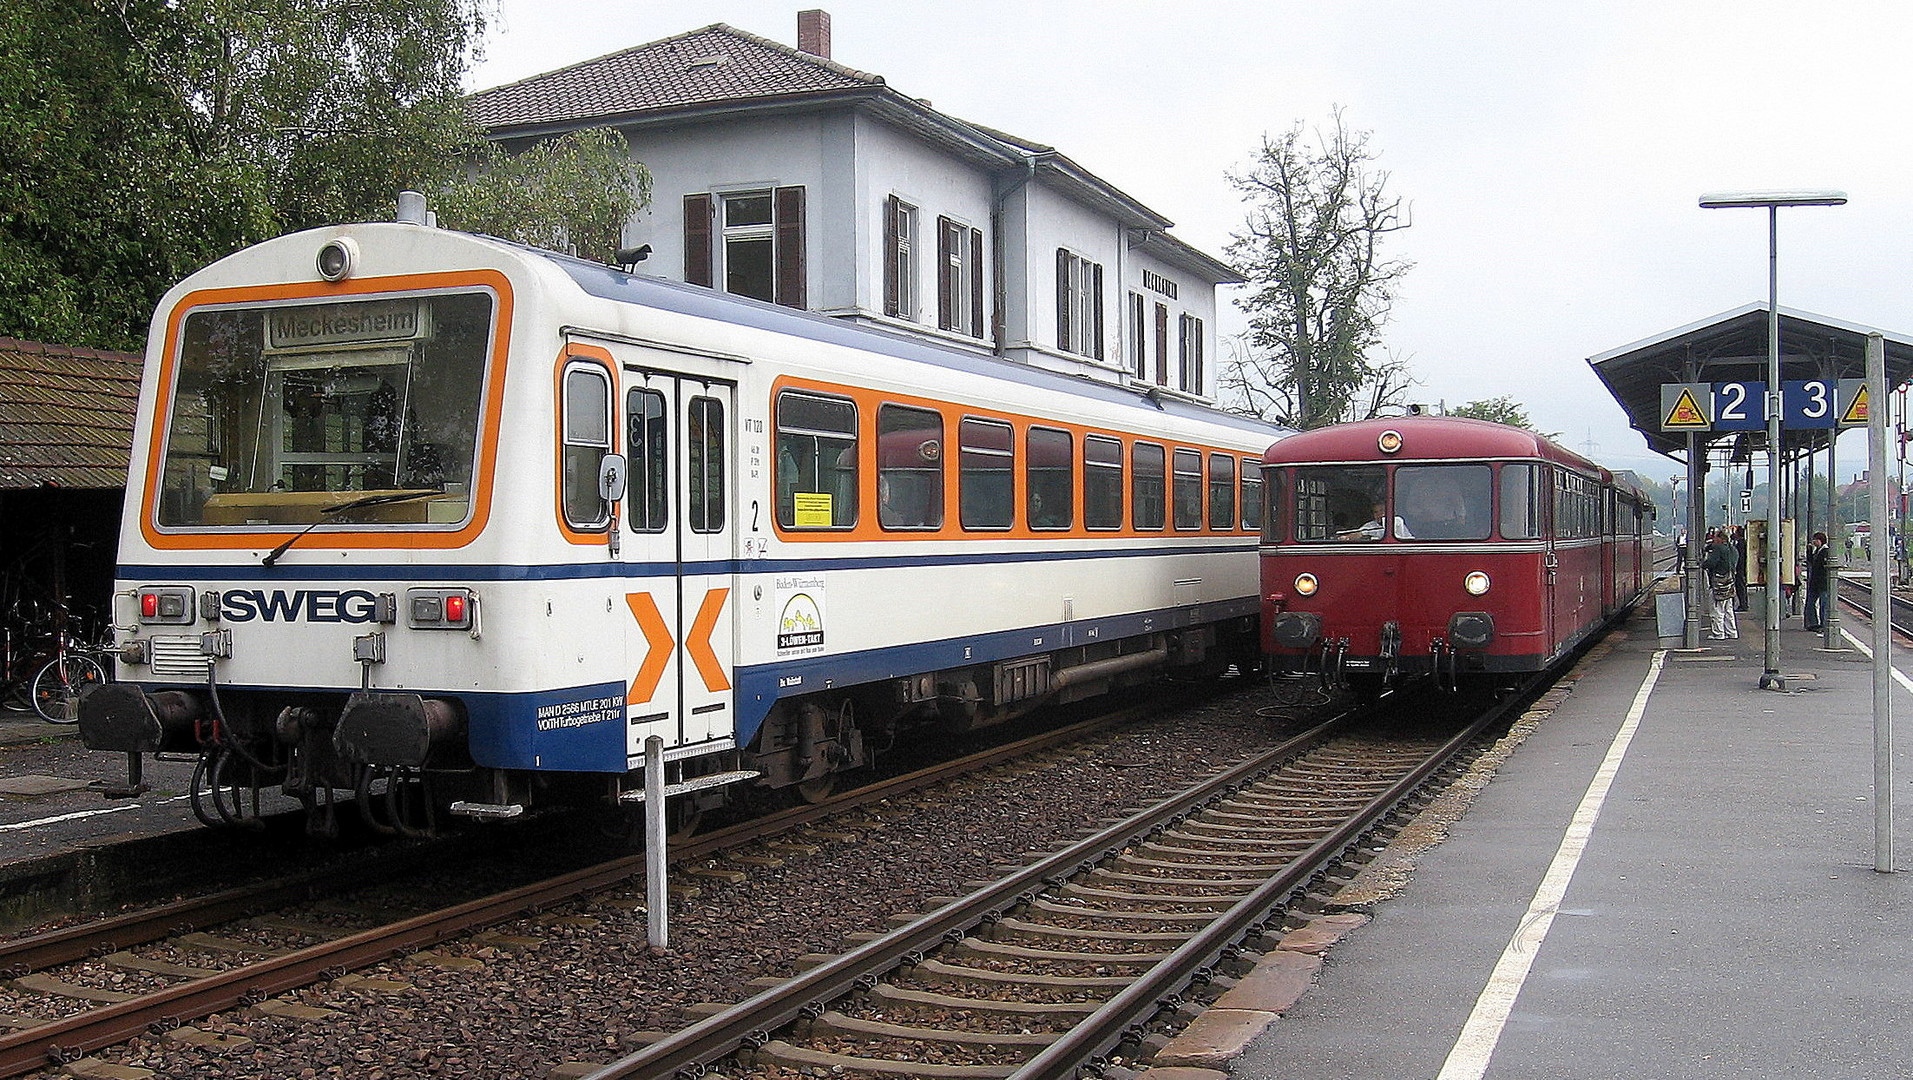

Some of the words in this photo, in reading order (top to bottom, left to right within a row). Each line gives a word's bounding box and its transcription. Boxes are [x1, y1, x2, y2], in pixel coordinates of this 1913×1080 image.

[277, 312, 415, 338] Meckesheim
[1721, 382, 1746, 420] 2
[1802, 381, 1828, 418] 3
[751, 499, 759, 532] 2
[221, 589, 379, 624] SWEG
[537, 706, 555, 719] MAN
[555, 705, 562, 716] D
[599, 697, 611, 709] 201
[537, 717, 560, 731] VOITH
[600, 710, 606, 721] T
